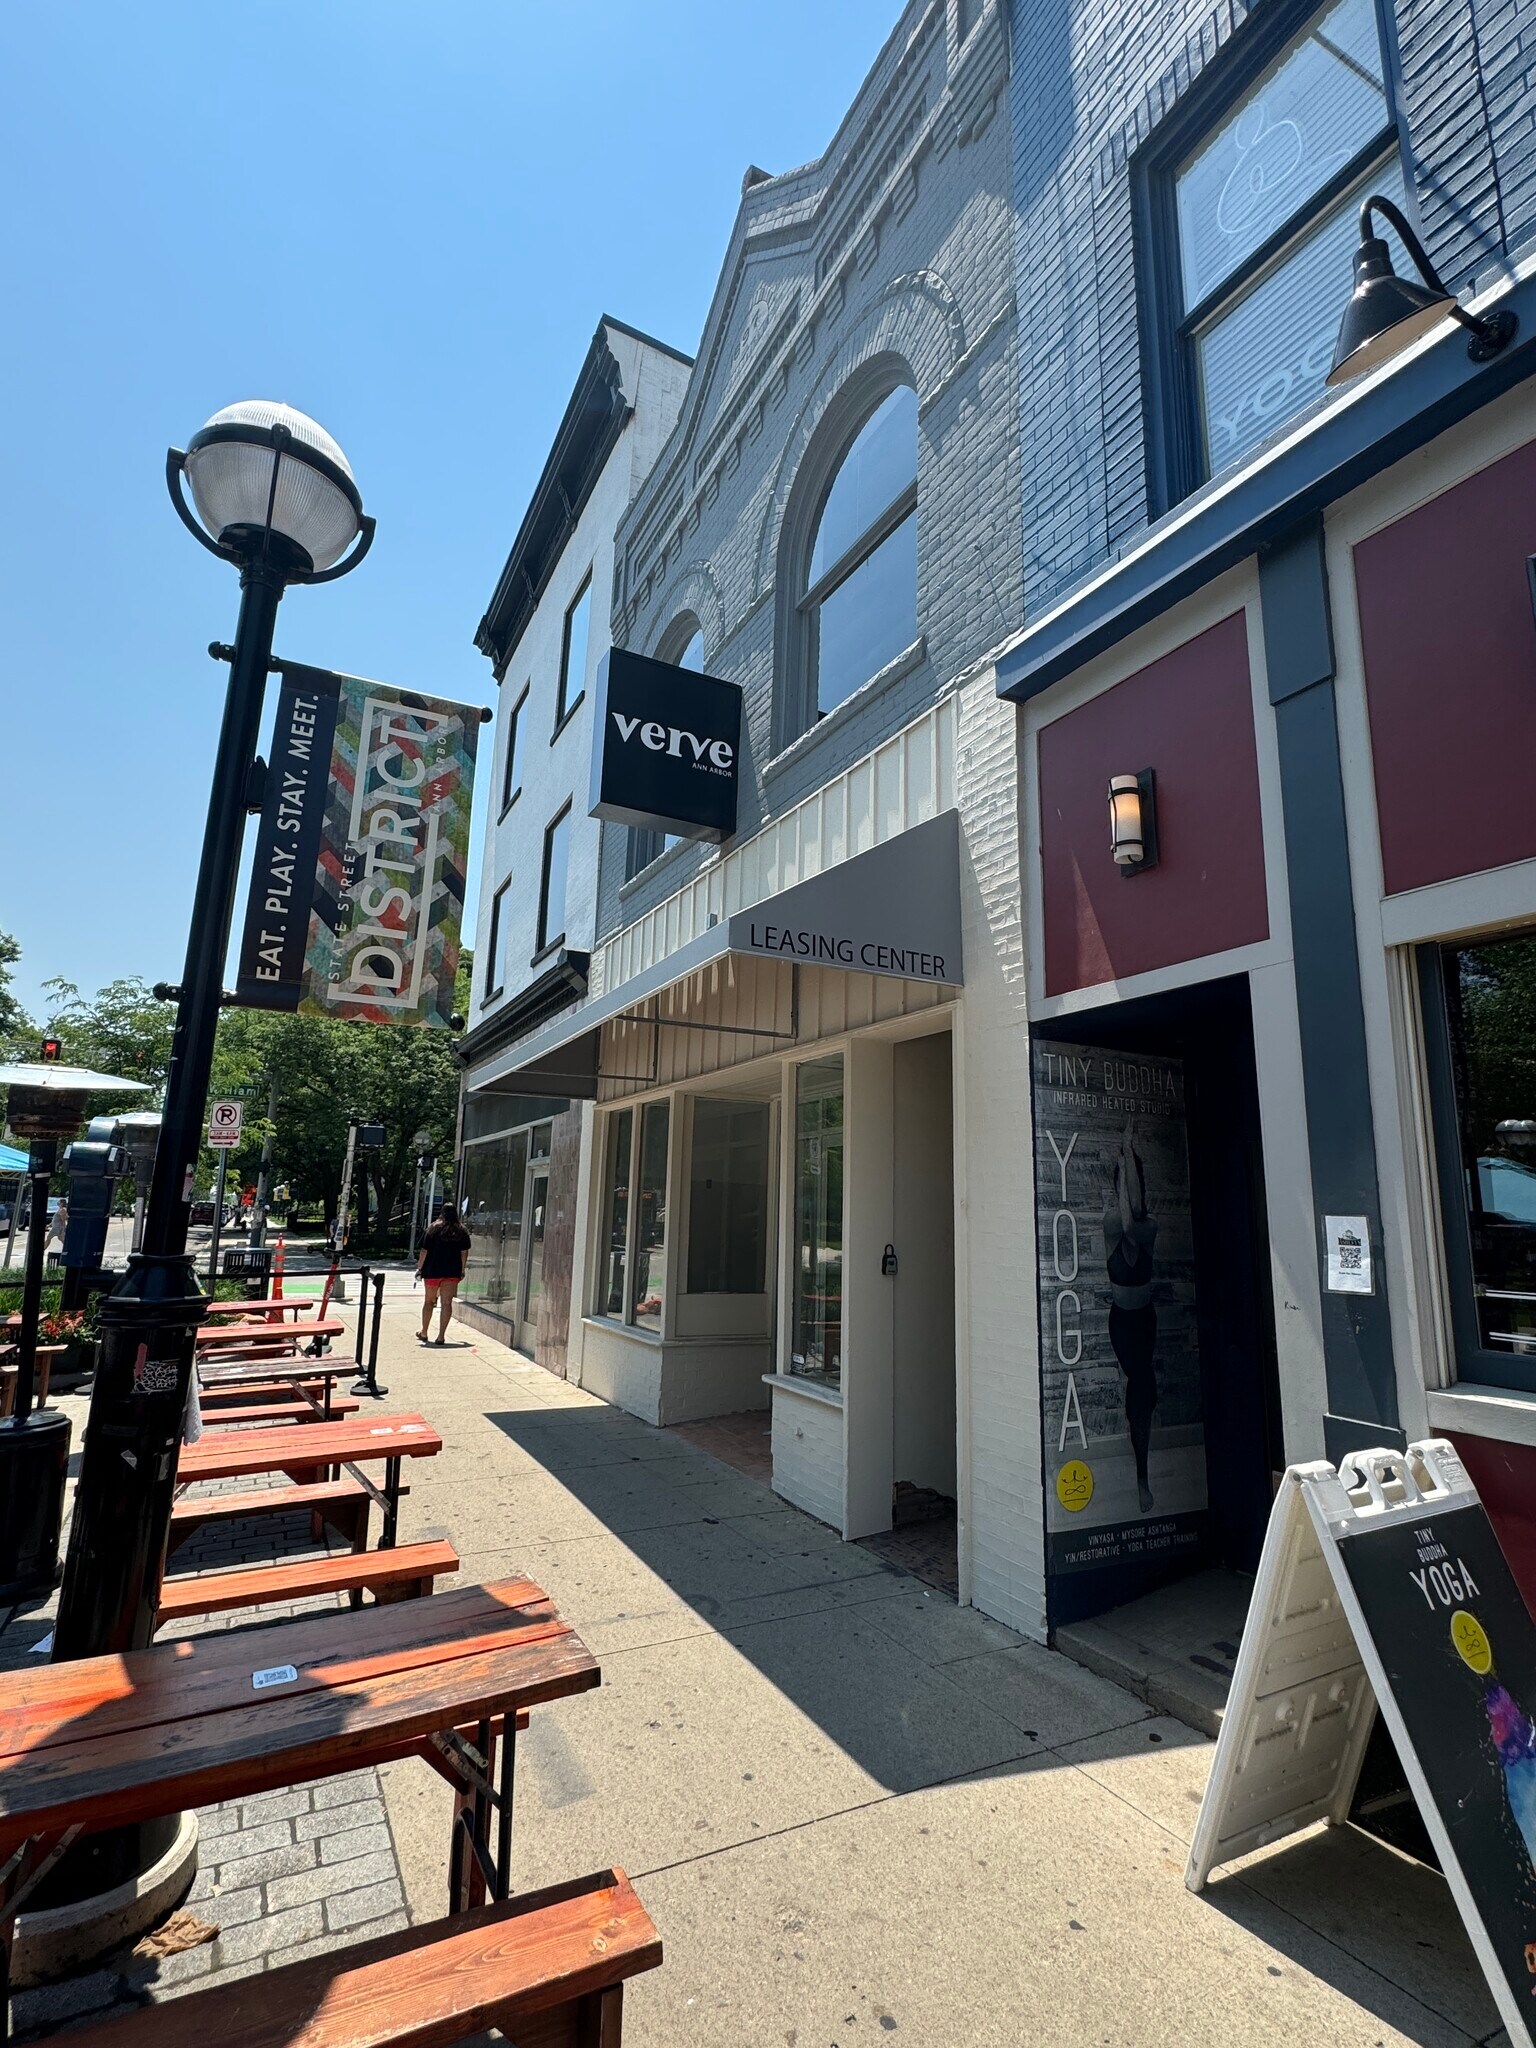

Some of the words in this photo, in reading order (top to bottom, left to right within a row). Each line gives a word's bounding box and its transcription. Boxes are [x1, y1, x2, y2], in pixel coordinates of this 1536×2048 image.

[288, 695, 319, 761] MEET.
[611, 711, 733, 768] verve
[429, 782, 443, 813] ANN
[692, 762, 708, 773] ANN
[709, 766, 732, 778] ARBOR
[276, 767, 309, 833] STAY.
[265, 842, 298, 914] PLAY.
[337, 841, 357, 912] STREET
[350, 715, 429, 989] DISTRICT
[256, 922, 287, 982] EAT.
[328, 922, 347, 981] STATE
[750, 923, 854, 963] LEASING
[860, 943, 946, 979] CENTER
[1043, 1053, 1092, 1088] TINY
[1103, 1061, 1177, 1097] BUDDHA
[1053, 1091, 1098, 1108] INFRARED
[1102, 1096, 1136, 1112] HEATED
[1140, 1100, 1171, 1116] STUDIO
[1045, 1129, 1089, 1453] YOGA
[1064, 1544, 1121, 1564] YIN/RESTORATIVE
[1127, 1540, 1143, 1552] YOGA
[1145, 1535, 1172, 1550] TEACHER
[1088, 1532, 1115, 1546] VINYASA
[1121, 1527, 1146, 1541] MYSORE
[1147, 1522, 1177, 1536] ASHTANGA
[1414, 1527, 1436, 1544] TINY
[1416, 1543, 1449, 1564] BUDDHA
[1409, 1557, 1481, 1611] YOGA
